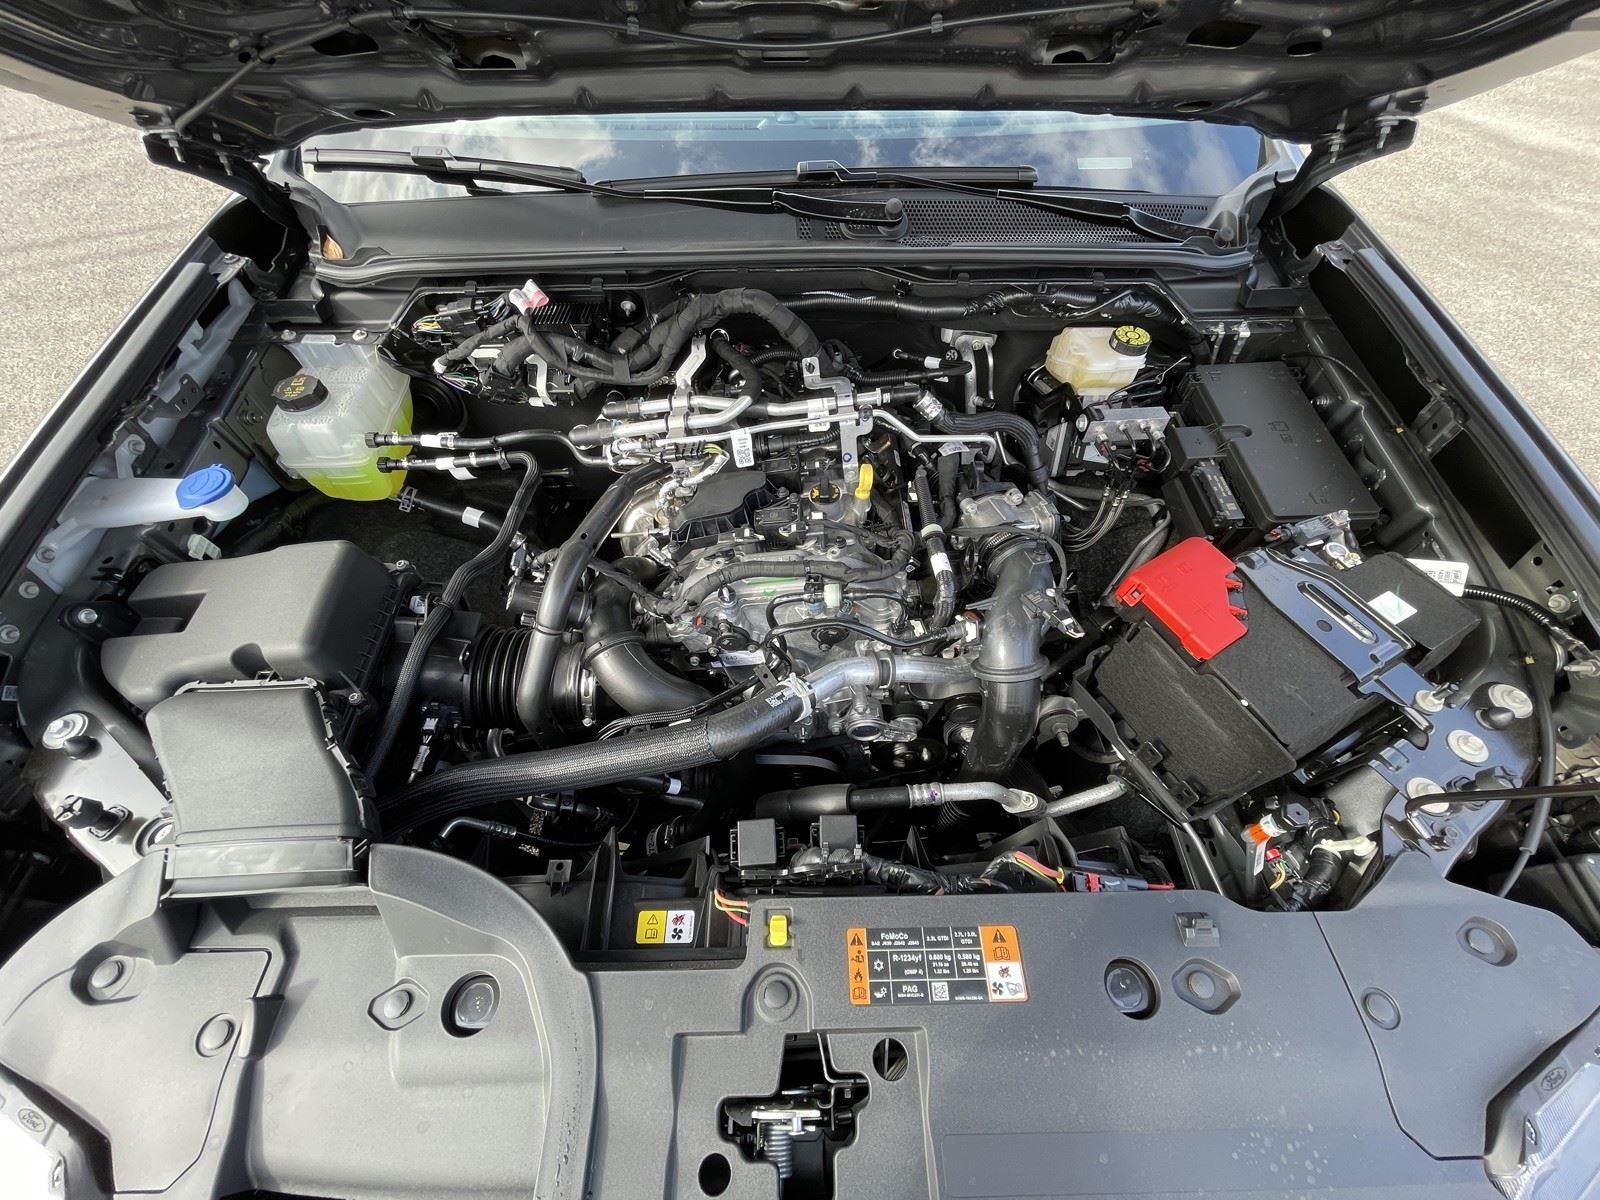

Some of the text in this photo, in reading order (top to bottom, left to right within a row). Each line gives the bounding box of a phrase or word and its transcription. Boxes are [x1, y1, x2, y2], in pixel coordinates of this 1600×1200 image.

[880, 932, 909, 940] FoMoCo
[892, 953, 922, 963] R-1234yf
[902, 984, 919, 993] PAG
